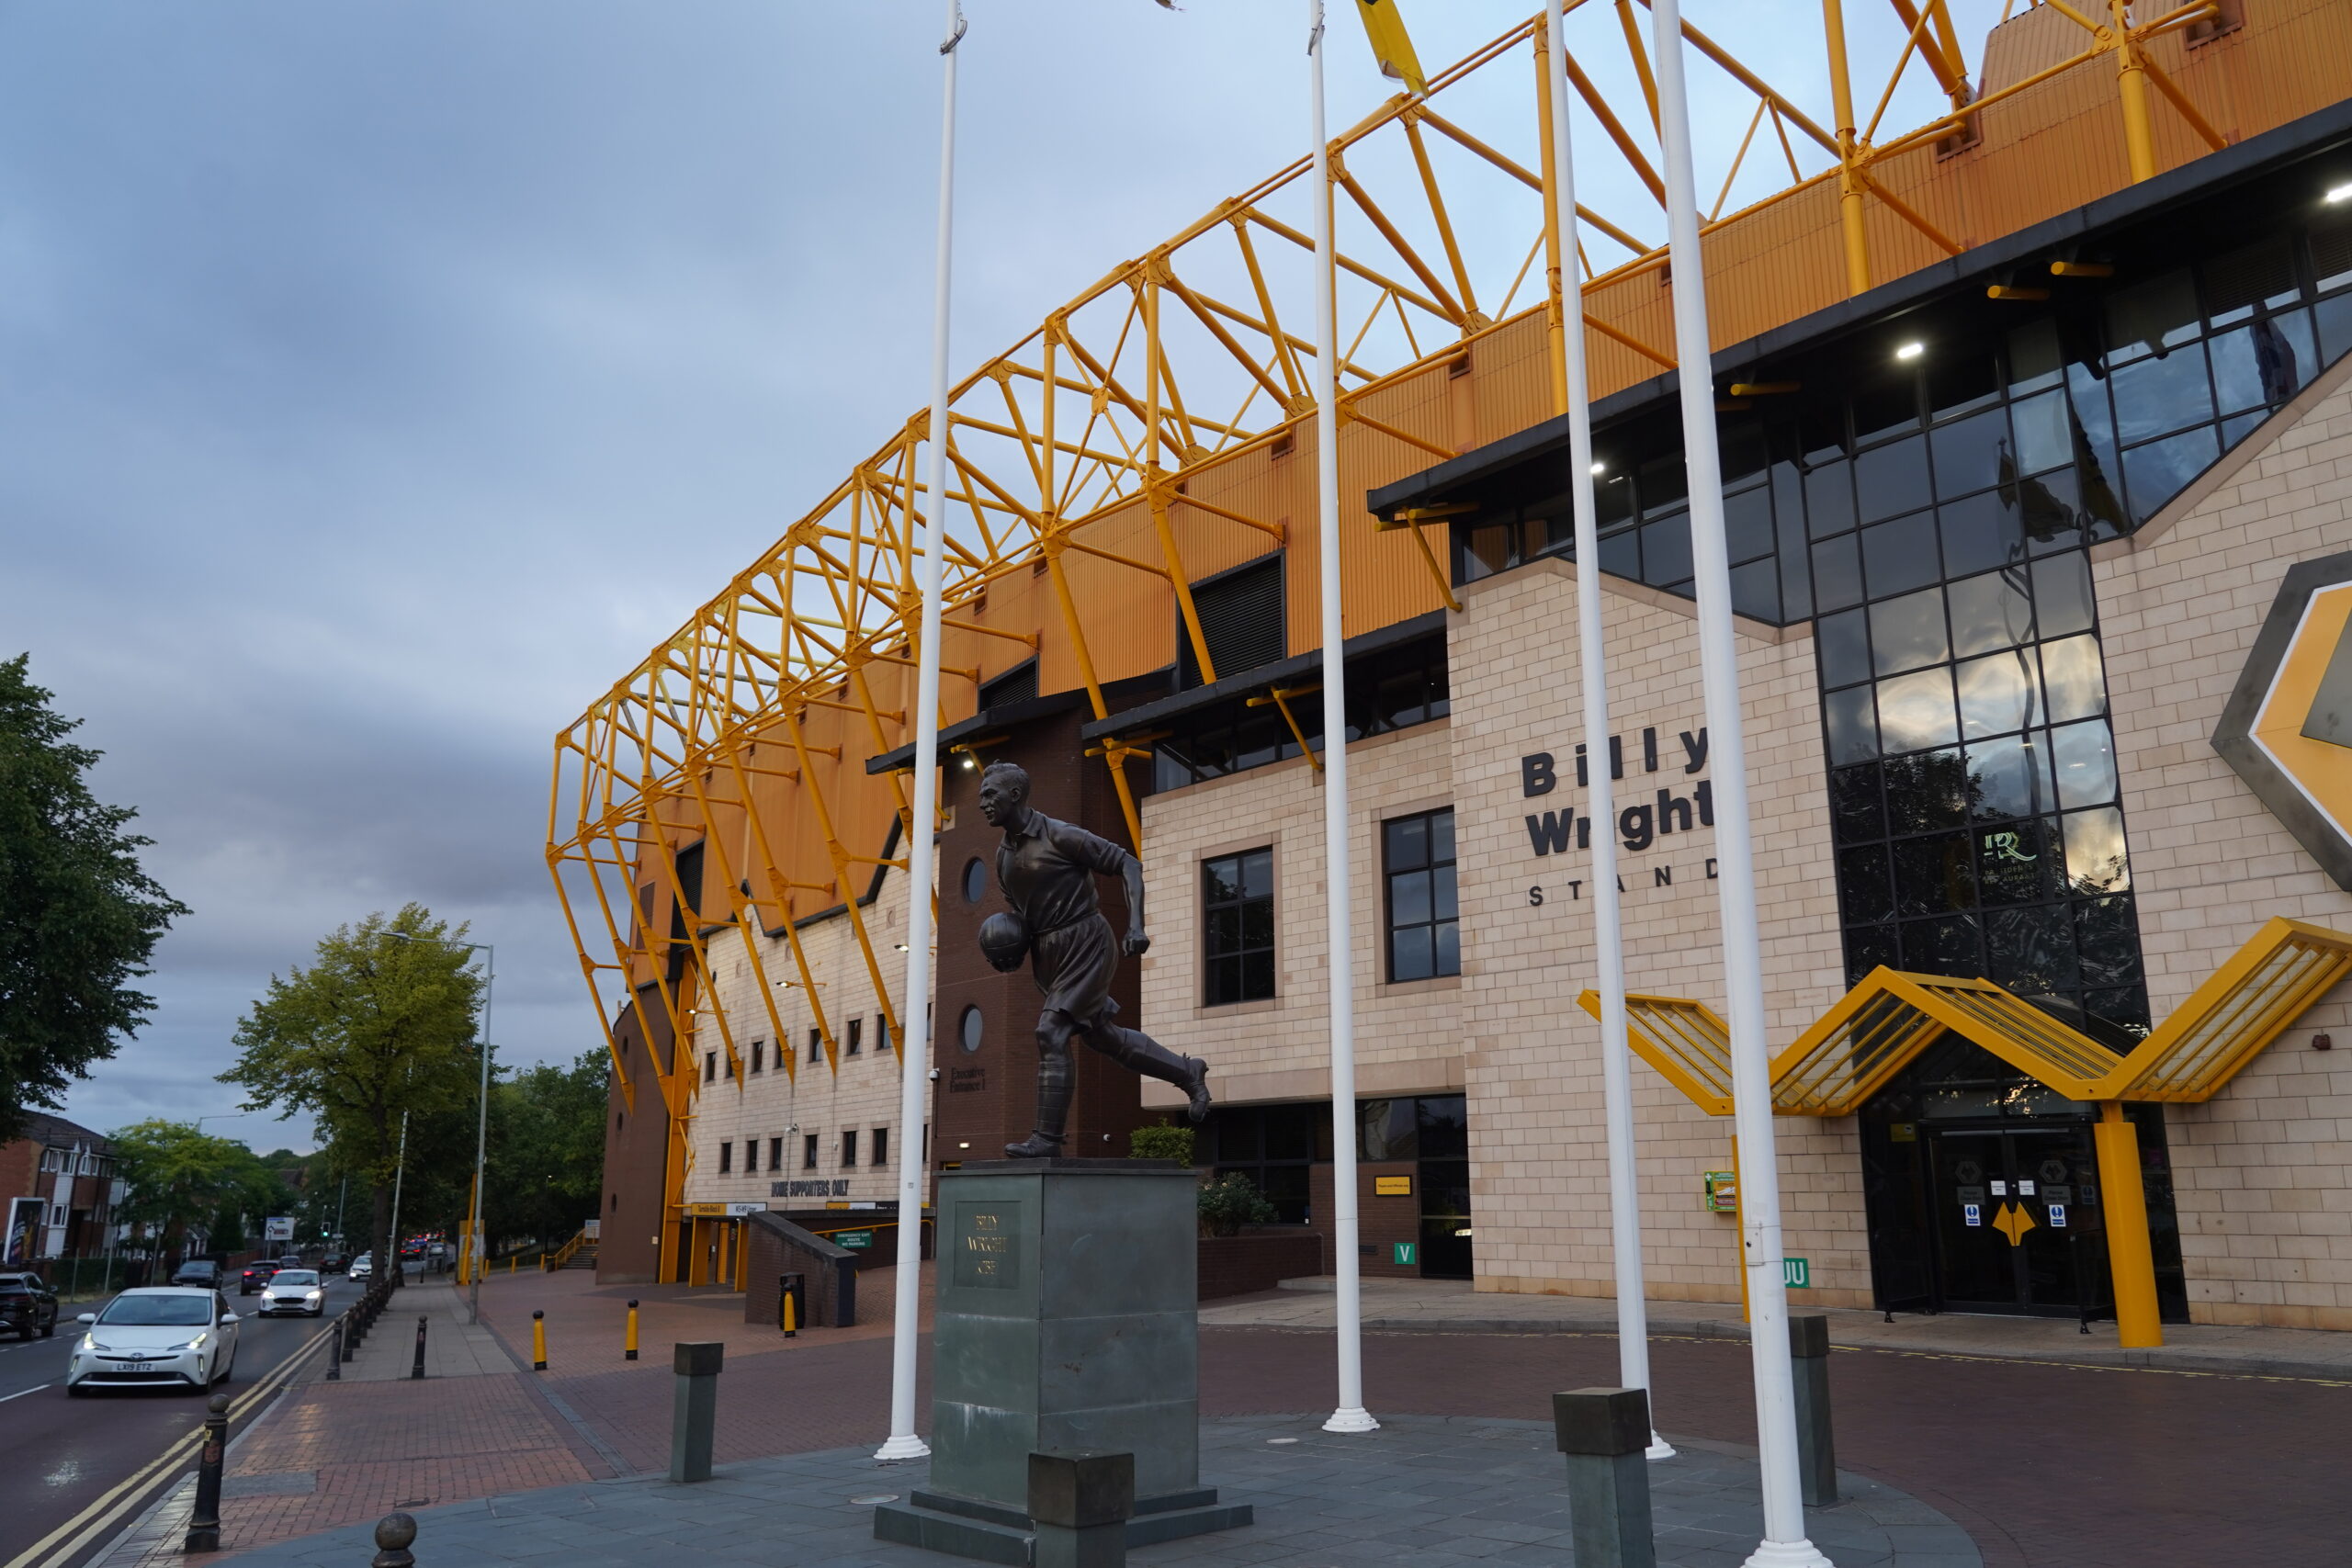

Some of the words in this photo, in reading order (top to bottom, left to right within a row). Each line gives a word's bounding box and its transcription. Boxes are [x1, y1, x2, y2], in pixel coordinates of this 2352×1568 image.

[1521, 727, 1709, 797] Billy
[1525, 780, 1714, 856] Wrght
[771, 1181, 788, 1197] HOME
[789, 1179, 830, 1197] SUPPORTERS
[831, 1179, 849, 1197] ONLY
[976, 1215, 999, 1231] BILLY
[967, 1235, 1007, 1252] WRIGHT
[1399, 1246, 1410, 1262] V
